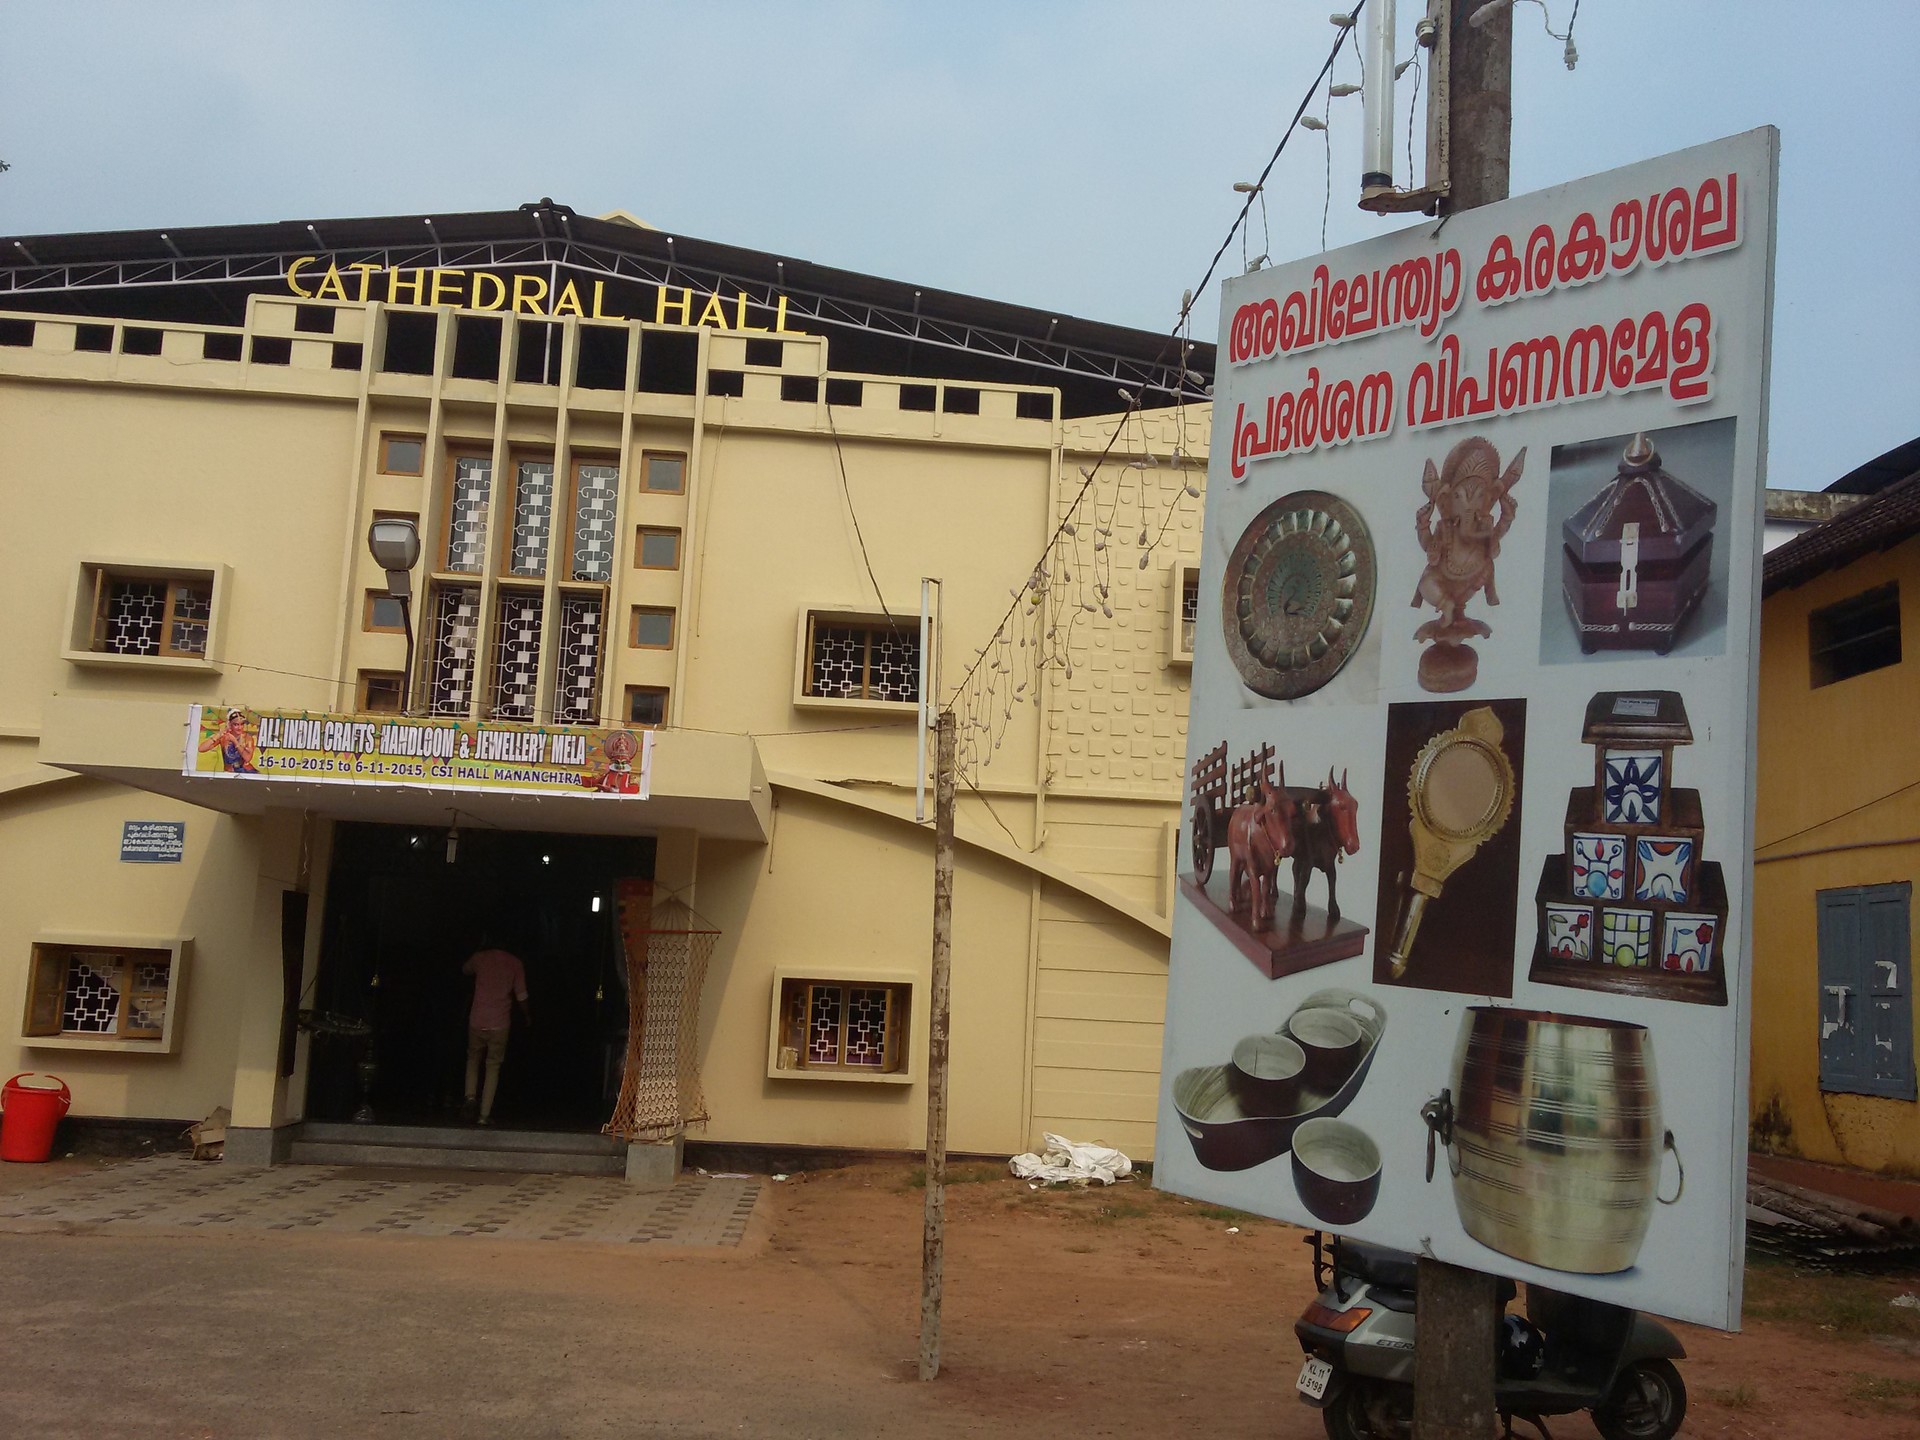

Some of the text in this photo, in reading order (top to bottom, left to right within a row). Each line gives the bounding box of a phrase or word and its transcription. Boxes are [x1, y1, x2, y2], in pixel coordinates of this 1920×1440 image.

[1229, 172, 1738, 364] അഖിലേന്ത്യാ കരകൗശല
[287, 256, 807, 335] CATHEDRAL HALL
[1230, 301, 1712, 480] പ്രദർശന വിപണനമേള
[257, 717, 587, 765] ALL INDIA CRAFTS HANDLOOM & JEWELLERY MELA
[258, 756, 583, 785] 16-10-2015 to 6-11-2015, CSI HALL MANANCHIRA
[1376, 1339, 1415, 1350] ETER
[1300, 1374, 1323, 1393] U 5198
[1308, 1363, 1317, 1376] KL
